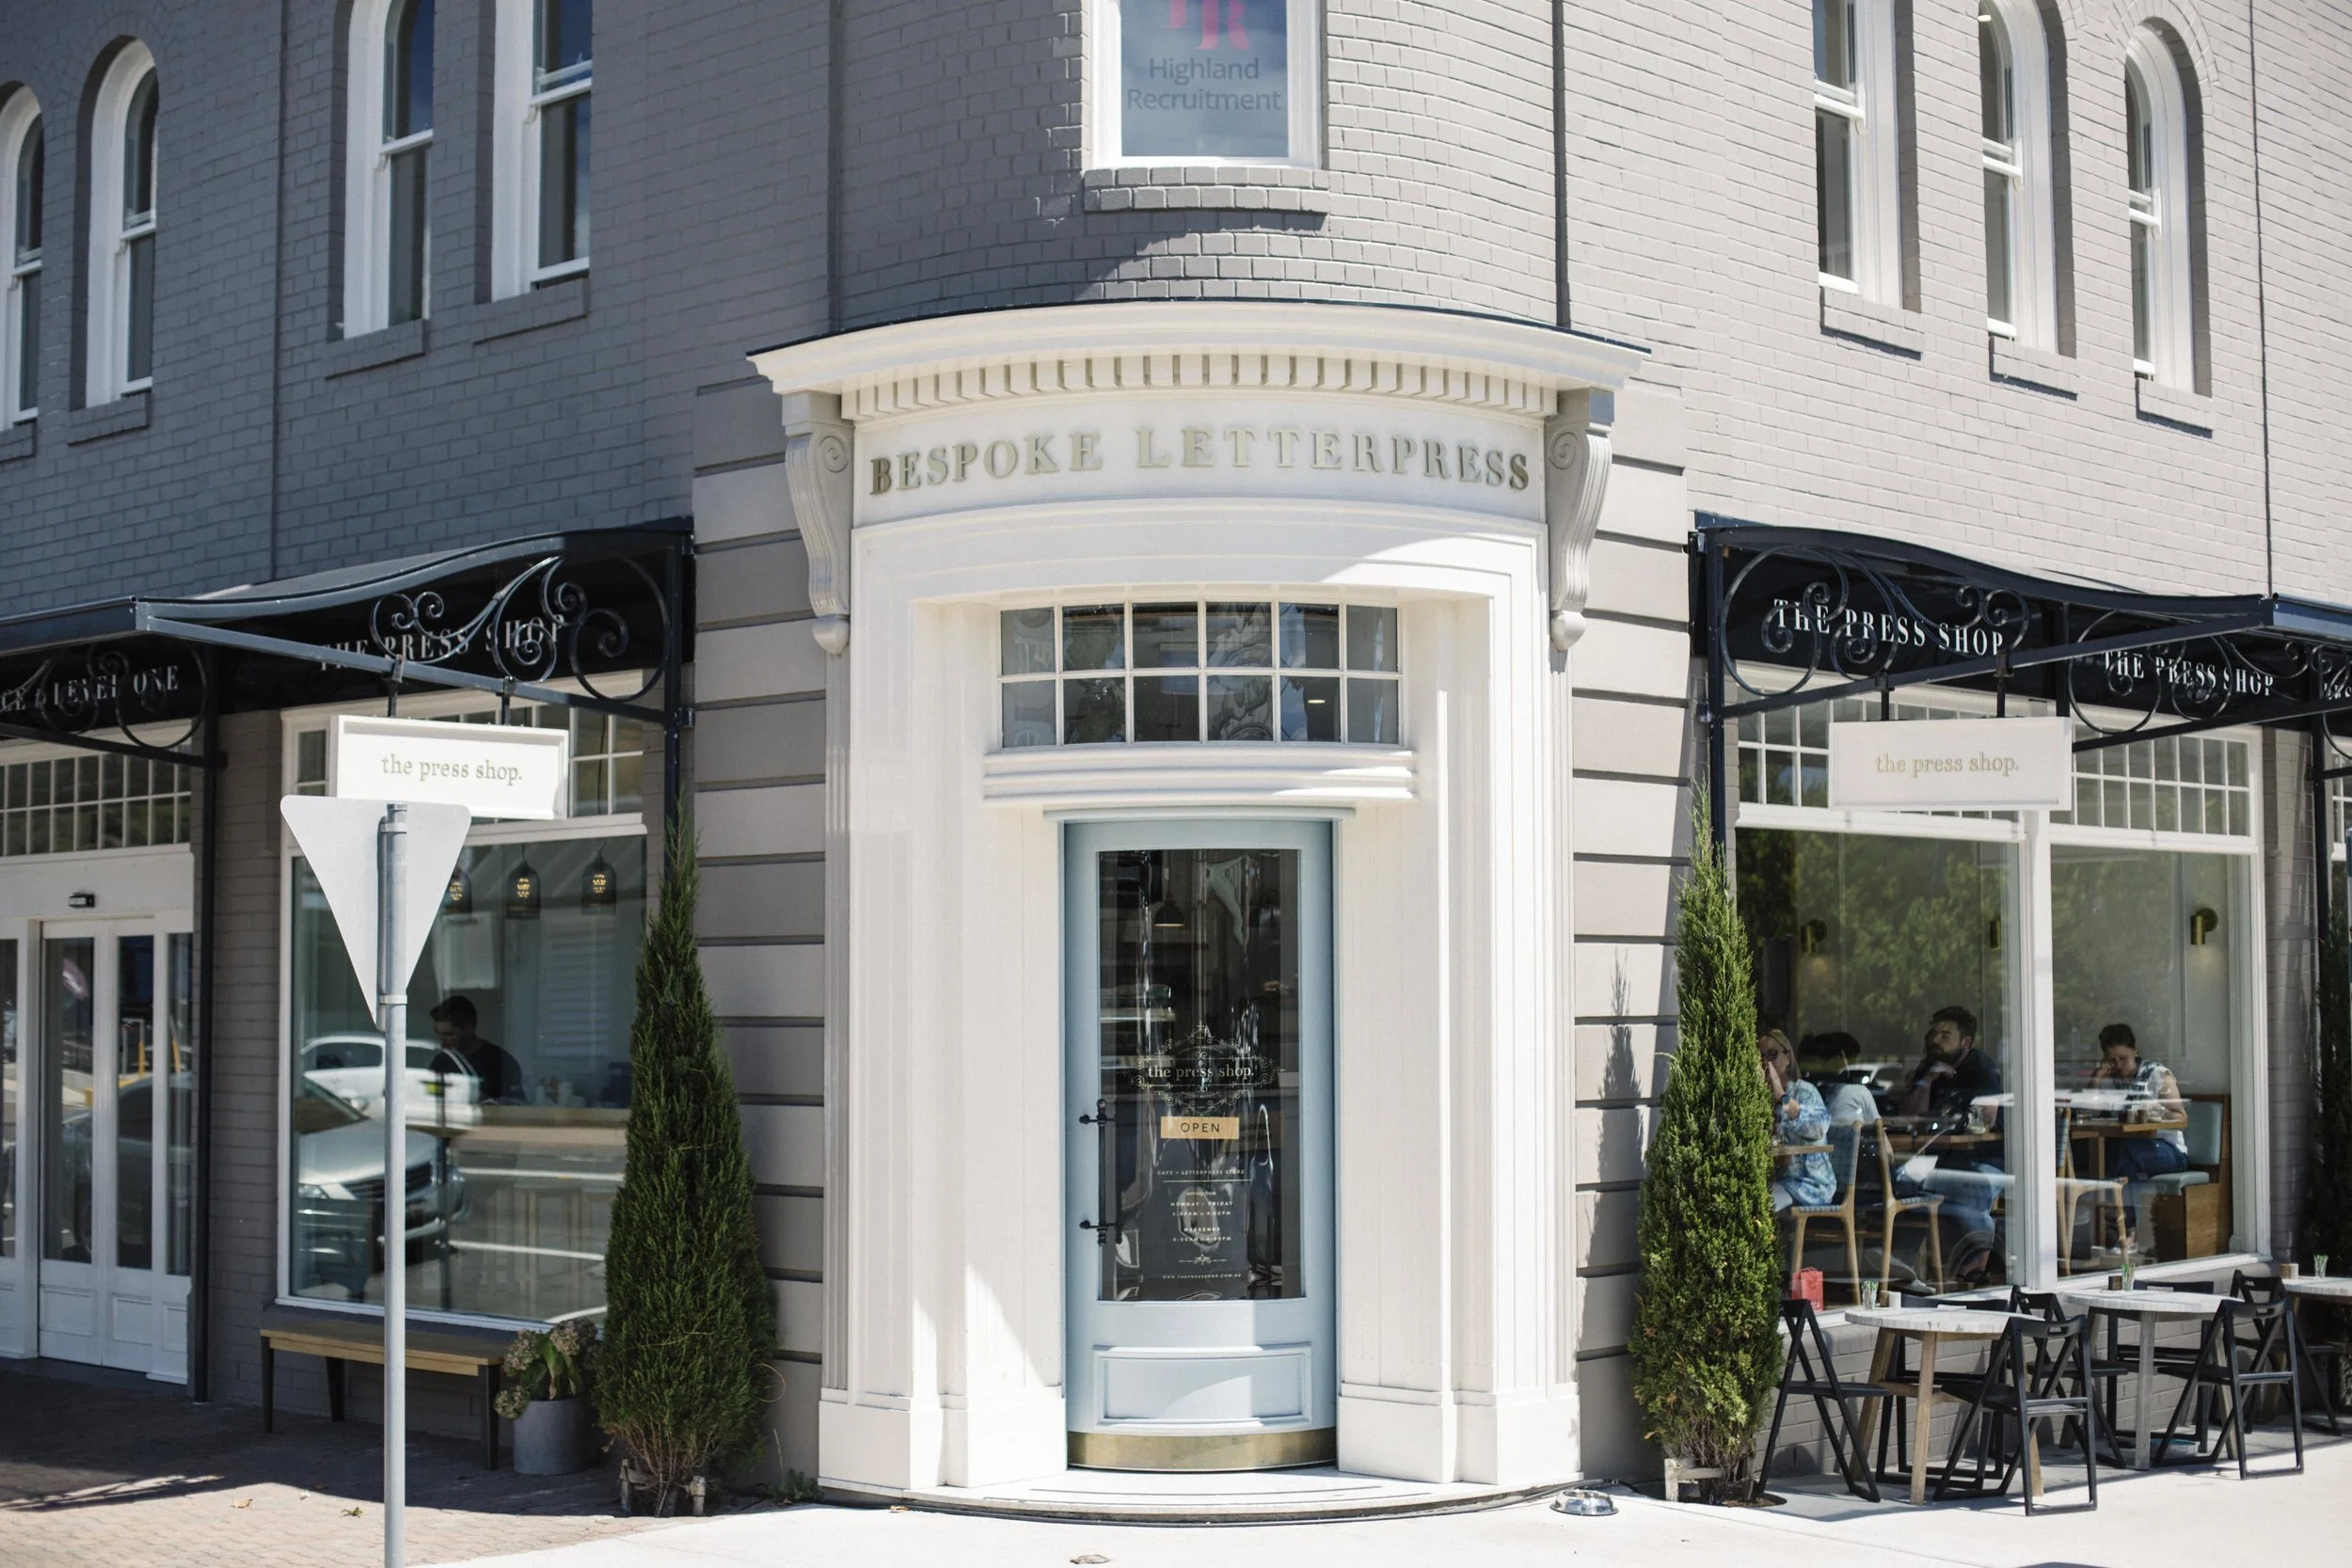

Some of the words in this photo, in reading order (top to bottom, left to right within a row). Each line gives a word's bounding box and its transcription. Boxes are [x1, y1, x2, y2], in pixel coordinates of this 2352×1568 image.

[1149, 57, 1260, 86] Highland
[1127, 88, 1282, 110] Recruitment
[869, 430, 1103, 496] BESPOKE
[1136, 427, 1530, 490] LETTERPRESS
[1773, 598, 1830, 634] THE
[1845, 609, 1926, 647] PRESS
[1938, 622, 2004, 656] SHOP
[384, 628, 470, 661] PRESS
[2102, 649, 2145, 678] THE
[2155, 657, 2217, 688] PRESS
[2223, 668, 2274, 696] SHOP
[381, 753, 413, 774] the
[419, 761, 469, 782] press
[475, 759, 522, 786] shop.
[1874, 753, 1906, 773] the
[1912, 758, 1963, 778] press
[1969, 752, 2020, 777] shop.
[1148, 1065, 1171, 1078] the
[1176, 1069, 1214, 1081] press
[1218, 1064, 1254, 1080] shop.
[1180, 1122, 1220, 1133] OPEN
